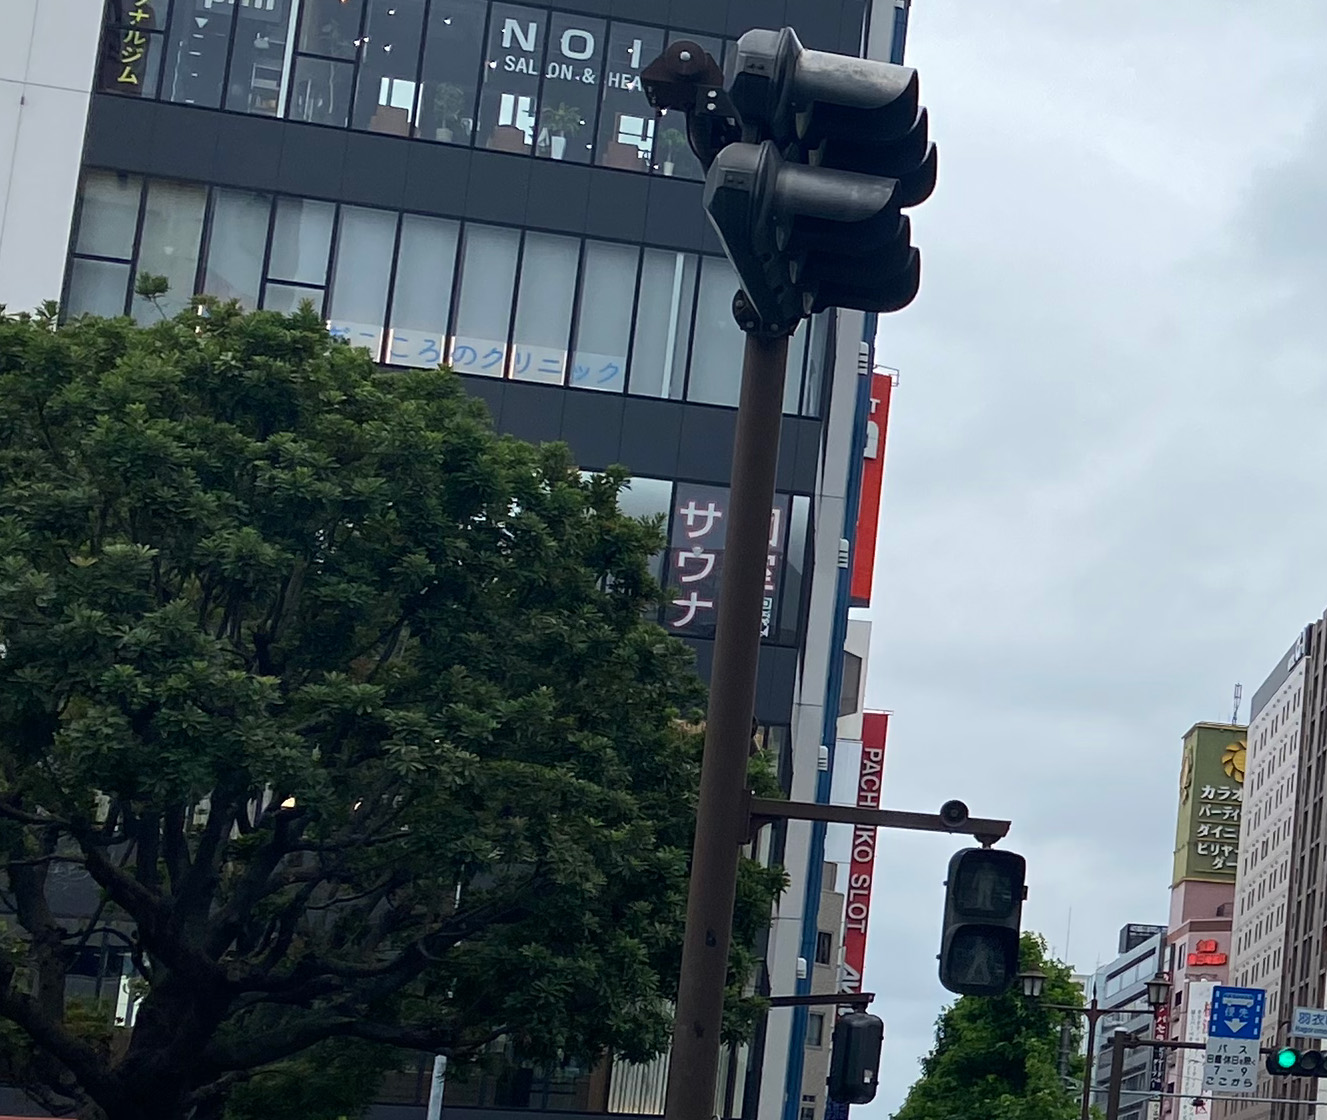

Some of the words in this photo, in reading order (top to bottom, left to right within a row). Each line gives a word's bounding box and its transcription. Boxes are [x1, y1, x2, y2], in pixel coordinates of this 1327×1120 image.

[504, 55, 573, 81] SALON
[581, 67, 596, 85] &
[672, 501, 722, 627] サウナ
[1198, 804, 1242, 821] パーティ
[847, 873, 871, 934] SLOT
[1205, 1076, 1253, 1088] ここから
